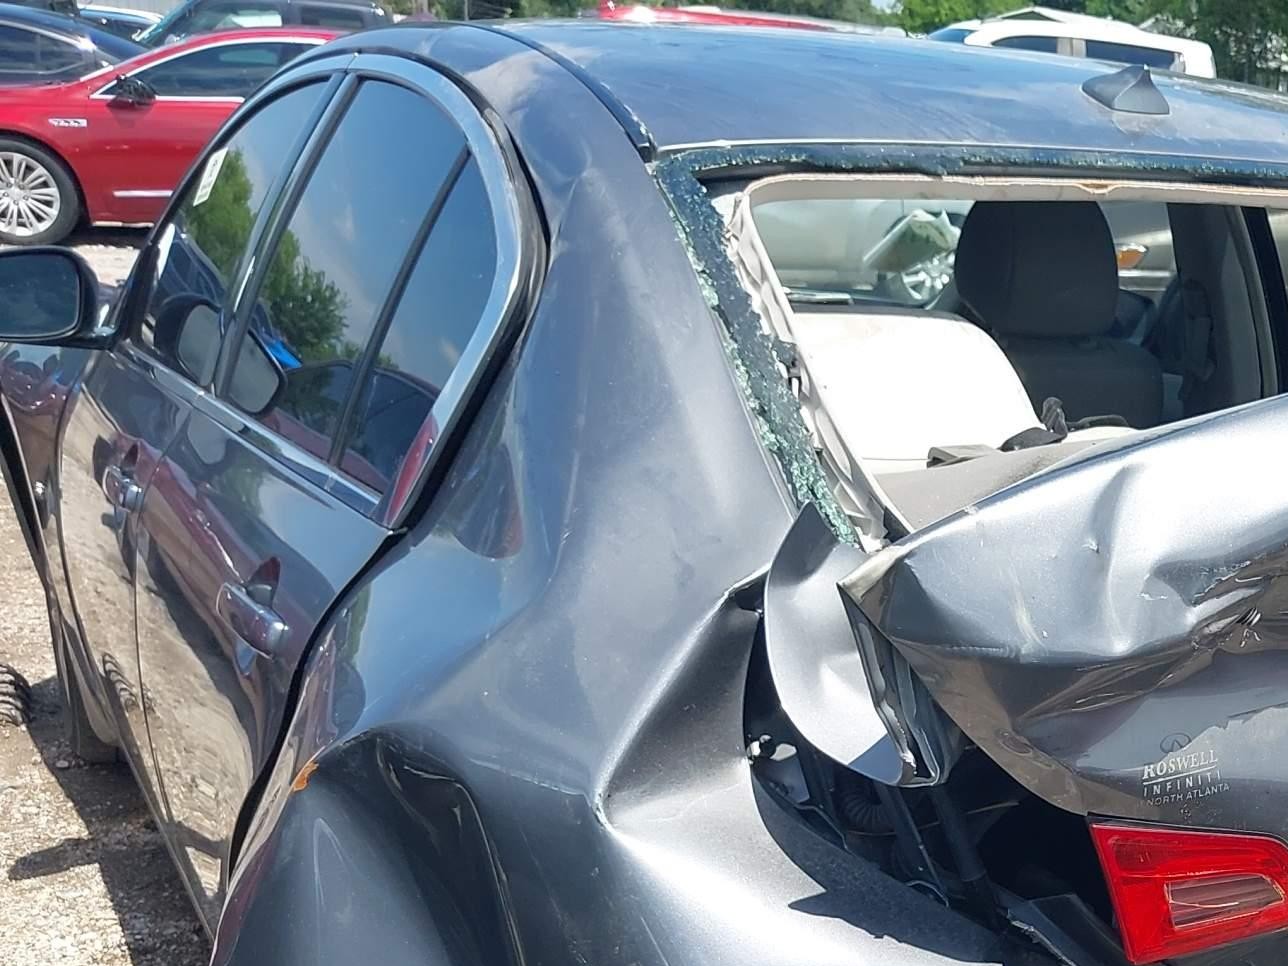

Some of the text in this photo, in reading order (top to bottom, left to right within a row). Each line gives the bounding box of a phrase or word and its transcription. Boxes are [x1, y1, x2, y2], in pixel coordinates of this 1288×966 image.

[1142, 750, 1218, 780] ROSWELL
[1143, 769, 1221, 797] INFINITI
[1147, 782, 1230, 806] NORTH ATLANTA
